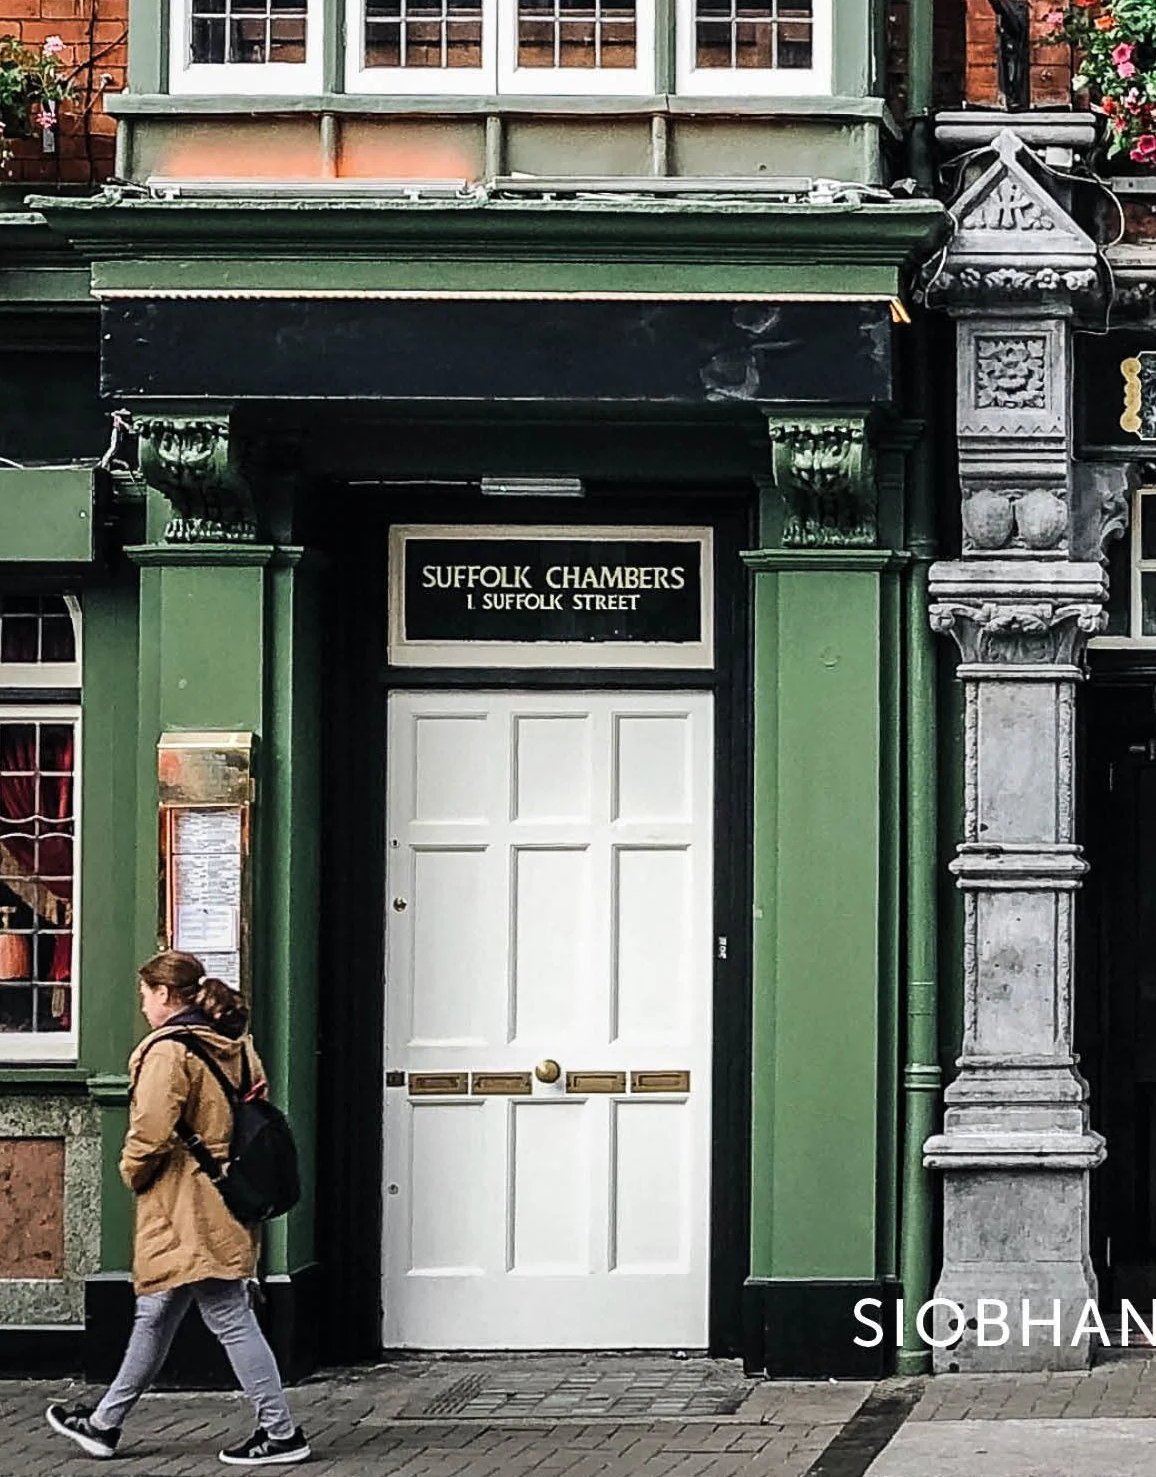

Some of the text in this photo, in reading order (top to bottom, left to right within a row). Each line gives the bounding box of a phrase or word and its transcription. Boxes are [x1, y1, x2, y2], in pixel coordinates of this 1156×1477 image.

[422, 565, 685, 590] SUFFOLK CHAMBERS
[482, 593, 564, 610] SUFFOLK
[573, 593, 640, 610] STREET
